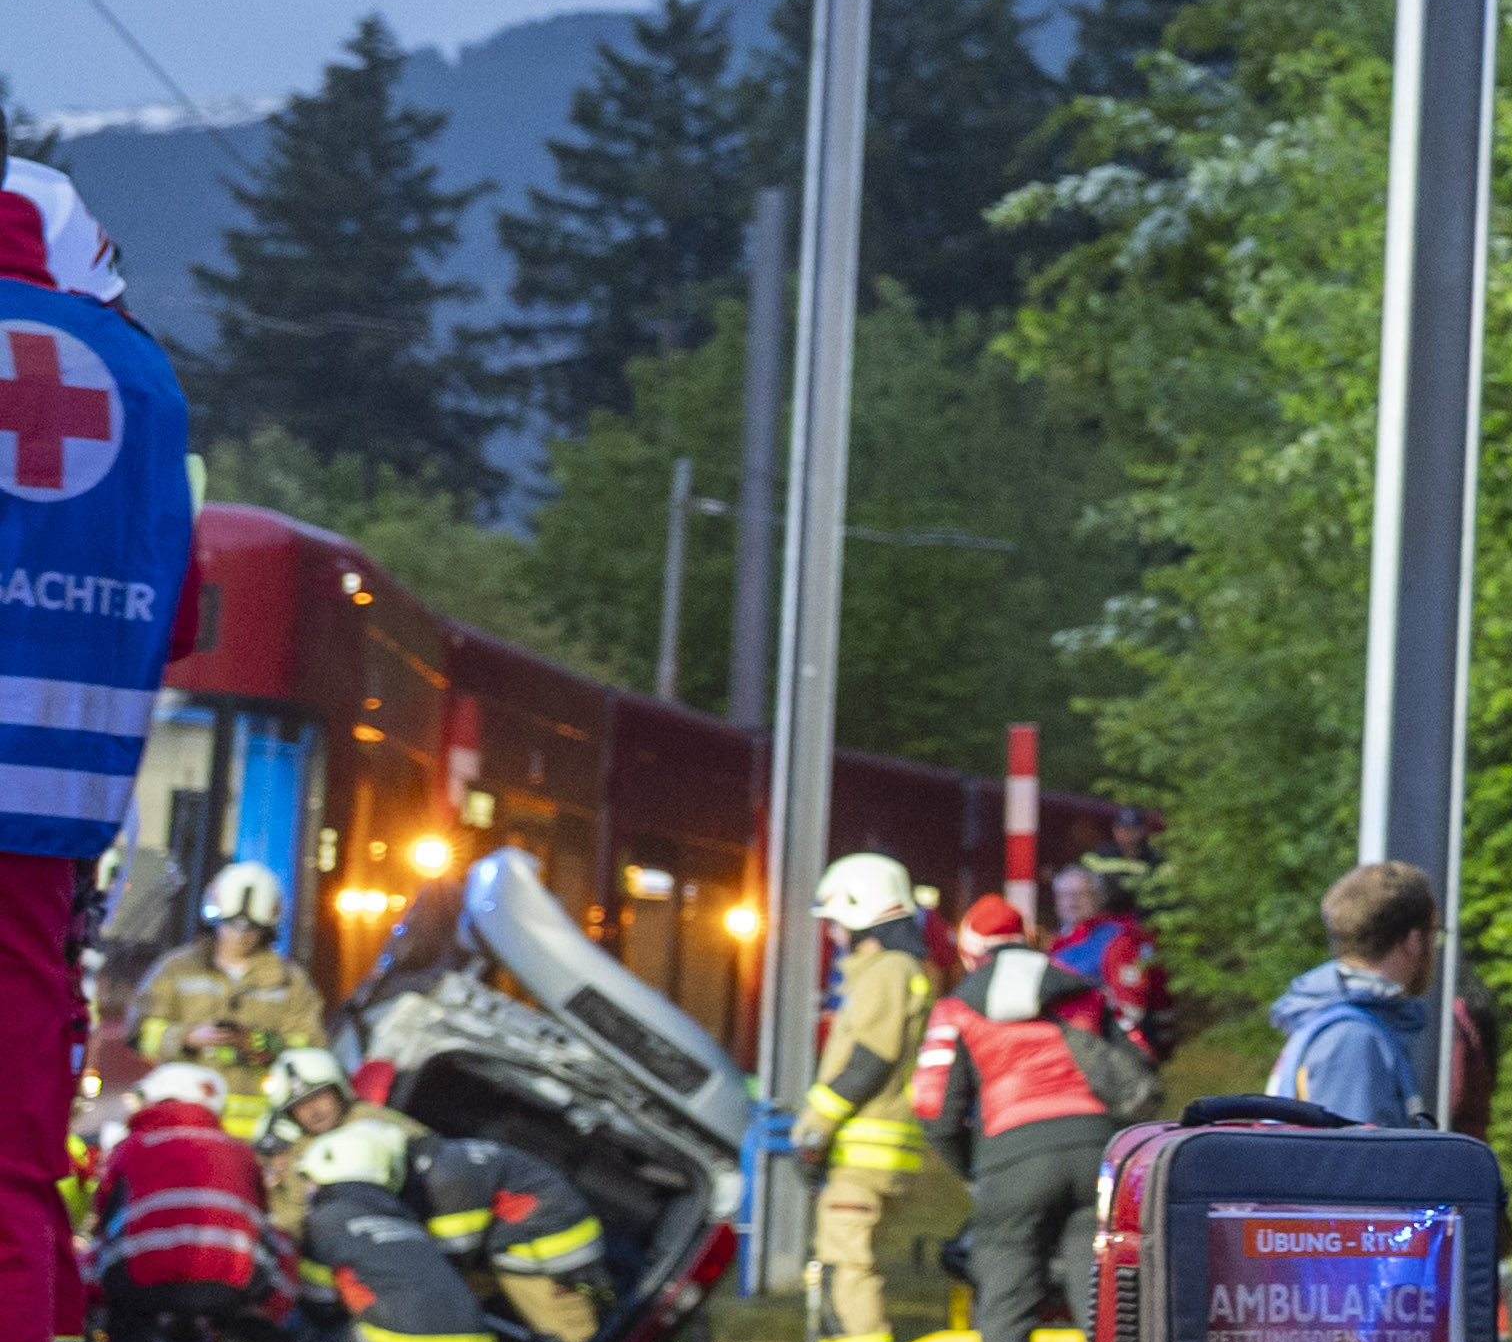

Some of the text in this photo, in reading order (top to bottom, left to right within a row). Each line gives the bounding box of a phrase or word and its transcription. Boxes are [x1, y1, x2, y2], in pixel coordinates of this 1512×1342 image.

[0, 568, 156, 623] ACHTER
[1256, 1229, 1343, 1253] ÜBUNG
[1208, 1283, 1437, 1324] AMBULANCE
